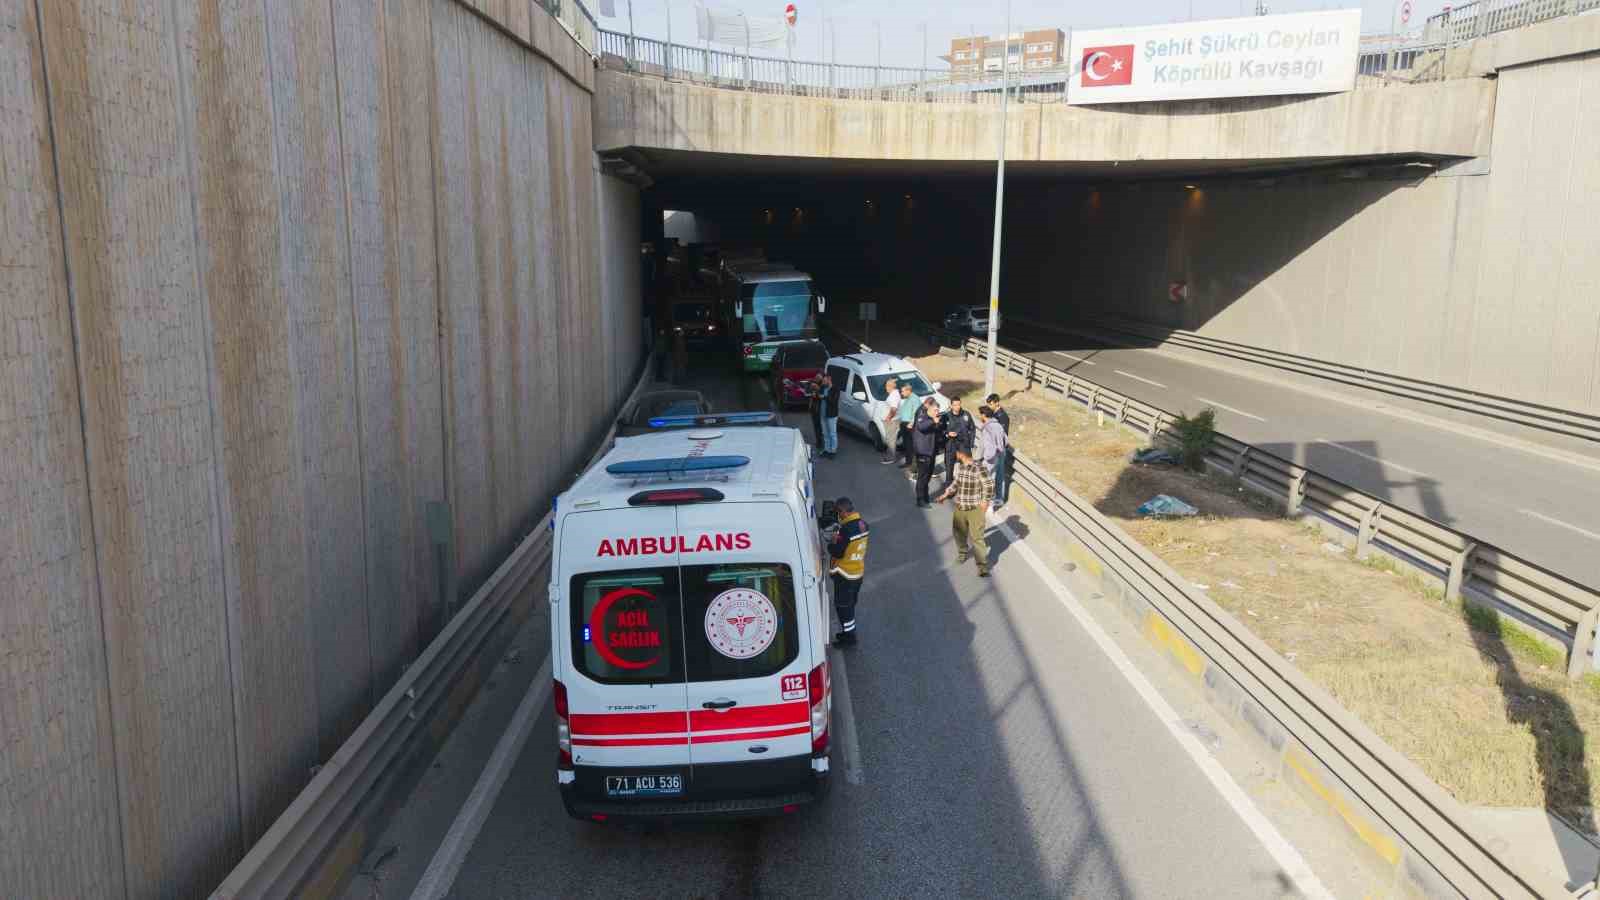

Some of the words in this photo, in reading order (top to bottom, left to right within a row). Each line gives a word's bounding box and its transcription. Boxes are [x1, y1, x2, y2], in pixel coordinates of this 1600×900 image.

[1143, 37, 1193, 62] Şehit
[1199, 32, 1262, 59] Şükrü
[1267, 28, 1341, 54] Ceylan
[1153, 60, 1233, 85] Köprülü
[1239, 57, 1325, 81] Kavşağı
[597, 532, 751, 557] AMBULANS
[784, 676, 803, 690] 112
[615, 777, 629, 791] 71
[636, 776, 656, 790] ACU
[659, 776, 680, 789] 536
